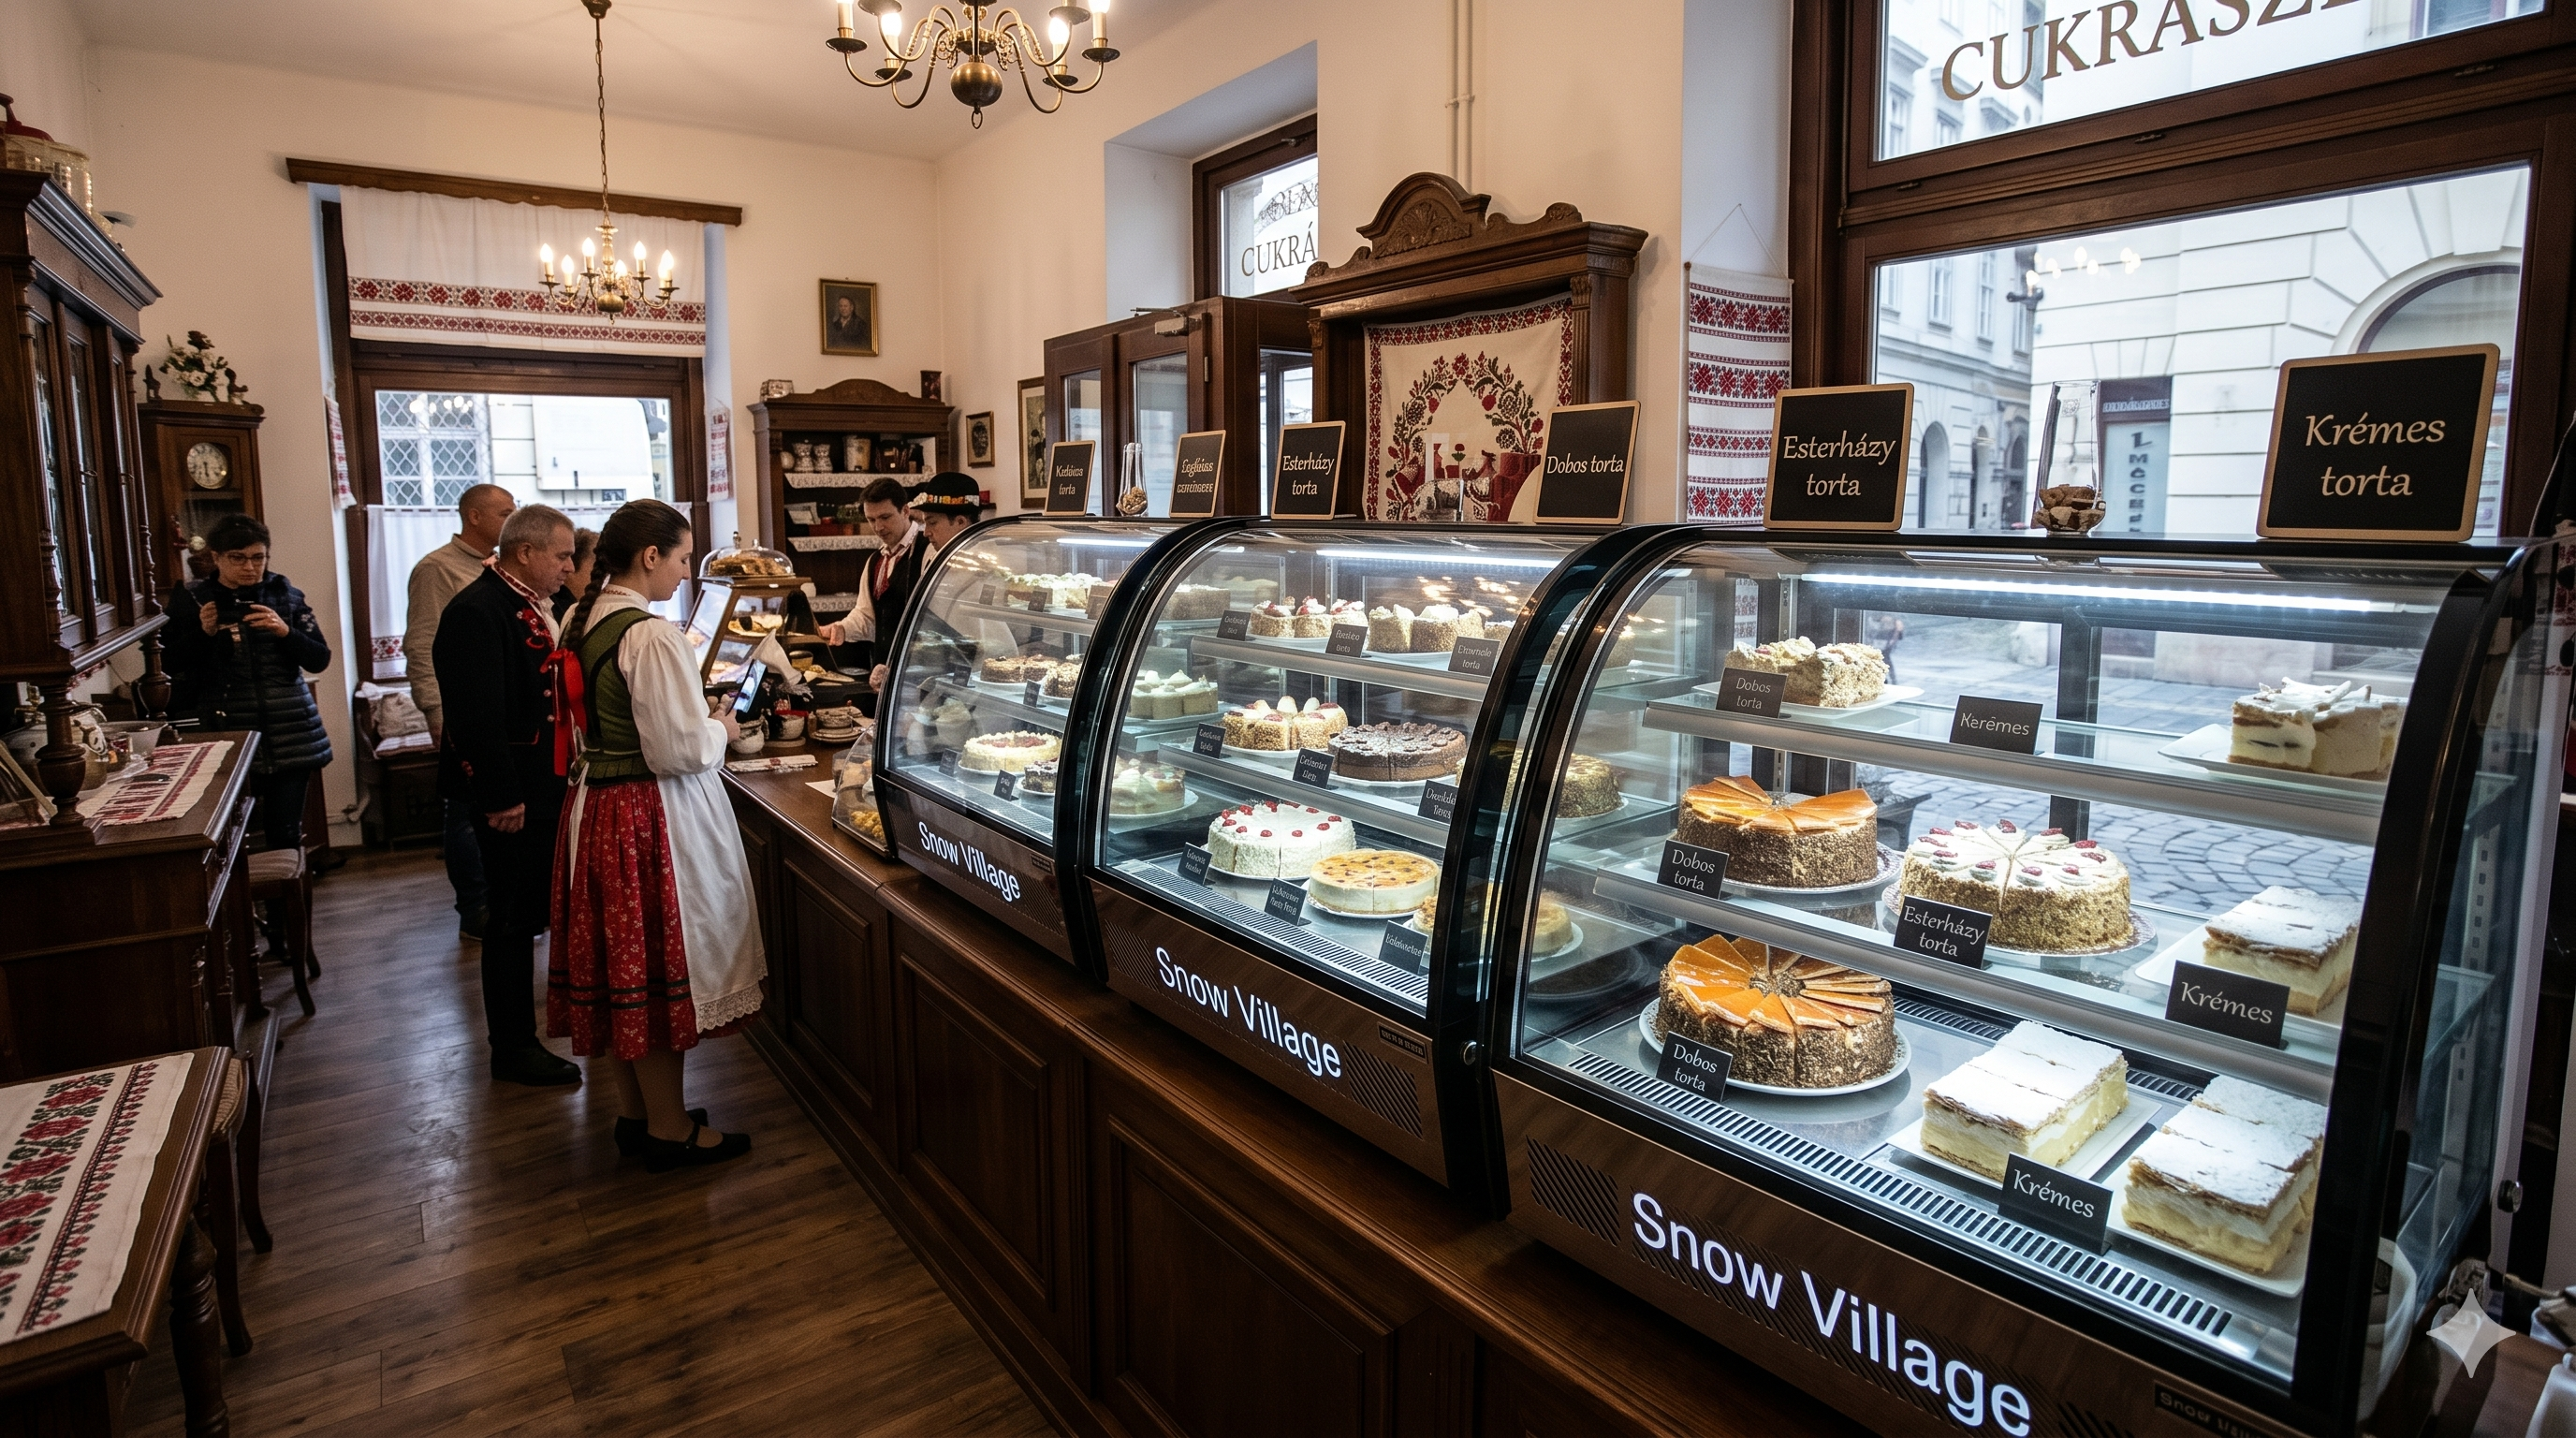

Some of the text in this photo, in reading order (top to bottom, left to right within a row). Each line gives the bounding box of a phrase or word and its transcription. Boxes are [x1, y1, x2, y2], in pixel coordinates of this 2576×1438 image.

[2305, 412, 2446, 447] Krémes
[1783, 430, 1896, 465] Esterházy
[1282, 451, 1335, 476] Esterházy
[1546, 452, 1624, 474] Dobos torta
[1292, 479, 1318, 495] torta
[1806, 473, 1862, 496] torta
[2320, 465, 2413, 496] torta
[1735, 677, 1771, 694] Dobos
[1736, 695, 1763, 710] torta
[918, 821, 1021, 902] Snow Village
[1672, 849, 1716, 874] Dobos
[1674, 870, 1705, 891] torta
[1903, 904, 1985, 946] Esterházy
[1919, 932, 1958, 957] torta
[1156, 946, 1341, 1078] Snow Village
[2181, 981, 2273, 1024] Krémes
[1673, 1043, 1718, 1074] Dobos
[1675, 1067, 1705, 1093] torta
[2013, 1168, 2095, 1218] Krémes
[1632, 1192, 2030, 1436] Snow Village
